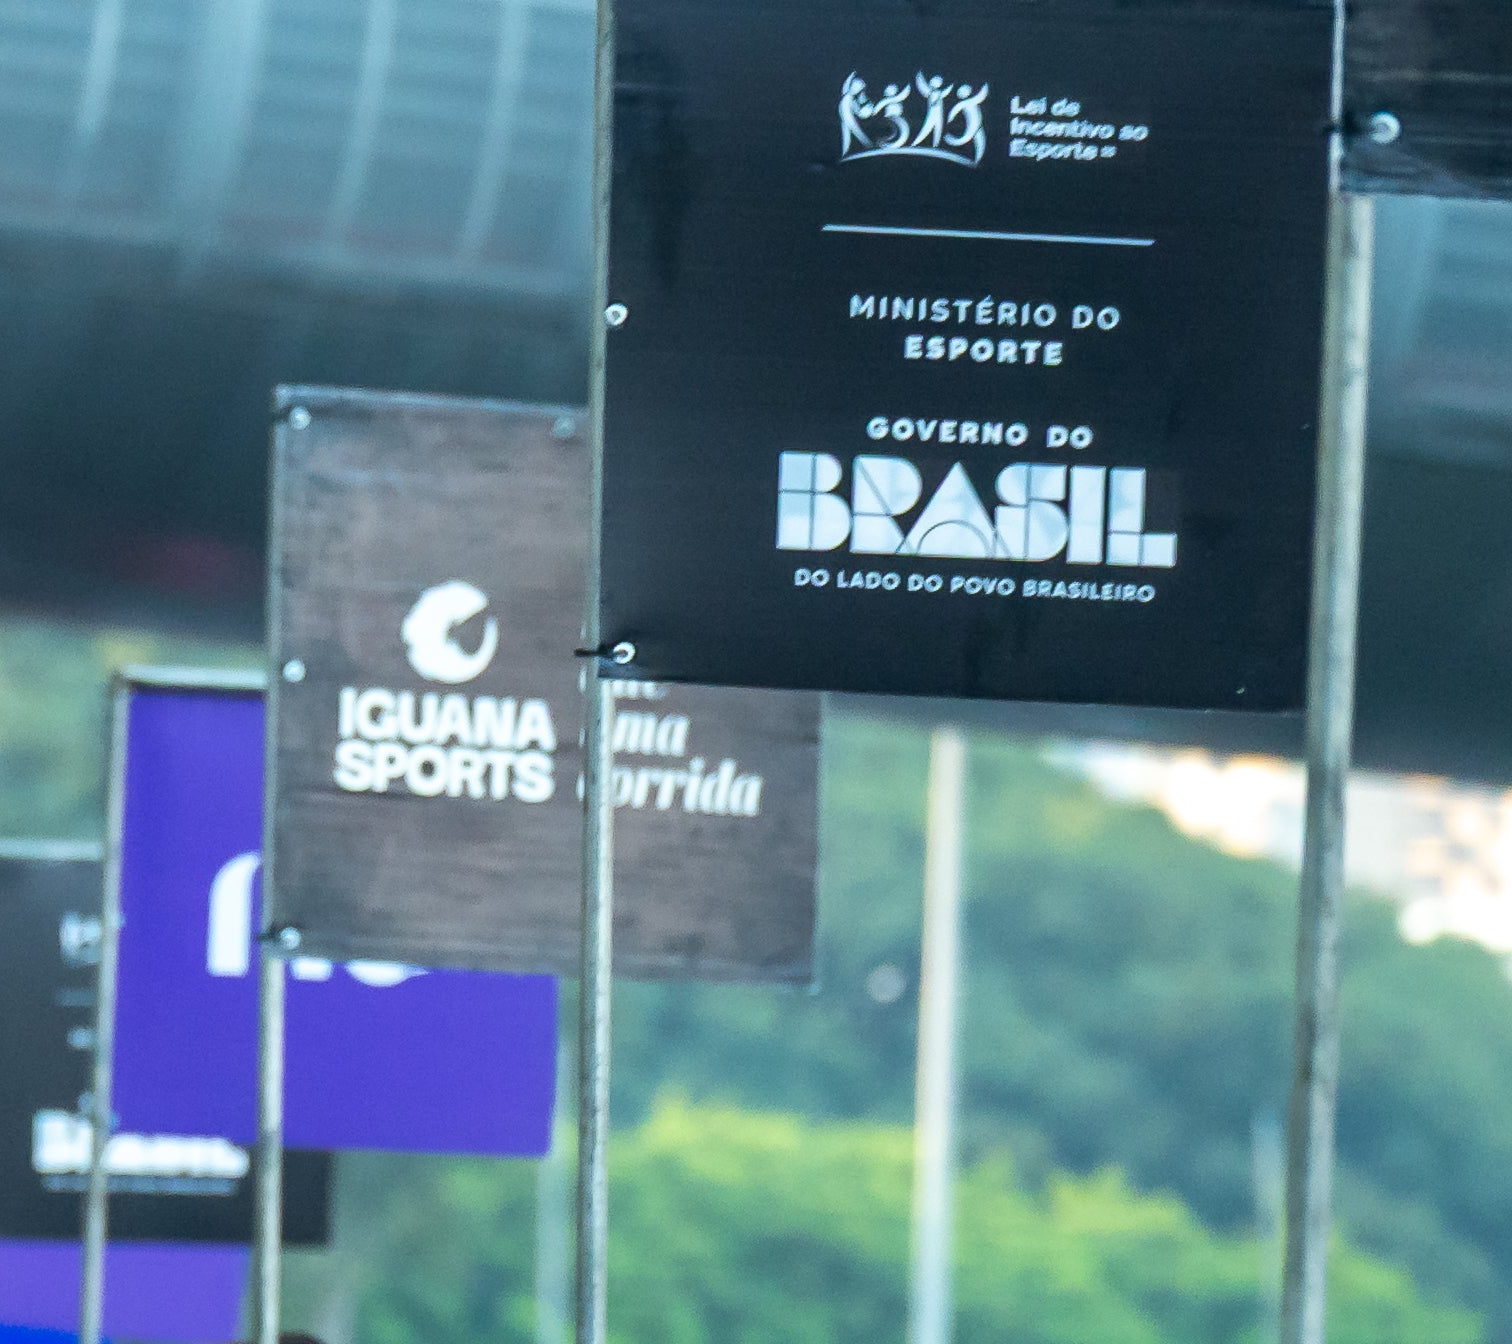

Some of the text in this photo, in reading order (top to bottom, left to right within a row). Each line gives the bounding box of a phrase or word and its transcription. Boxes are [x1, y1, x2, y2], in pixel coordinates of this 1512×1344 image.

[849, 294, 1121, 331] MINISTÉRIO DO
[904, 334, 1064, 367] ESPORTE
[866, 416, 1094, 450] GOVERNO DO
[775, 450, 1178, 569] BRASIL
[794, 568, 1156, 603] DO LADO DO POVO BRASILEIRO
[336, 685, 559, 753] IGUANA
[333, 740, 556, 804] SPORTS
[577, 756, 764, 818] orrida
